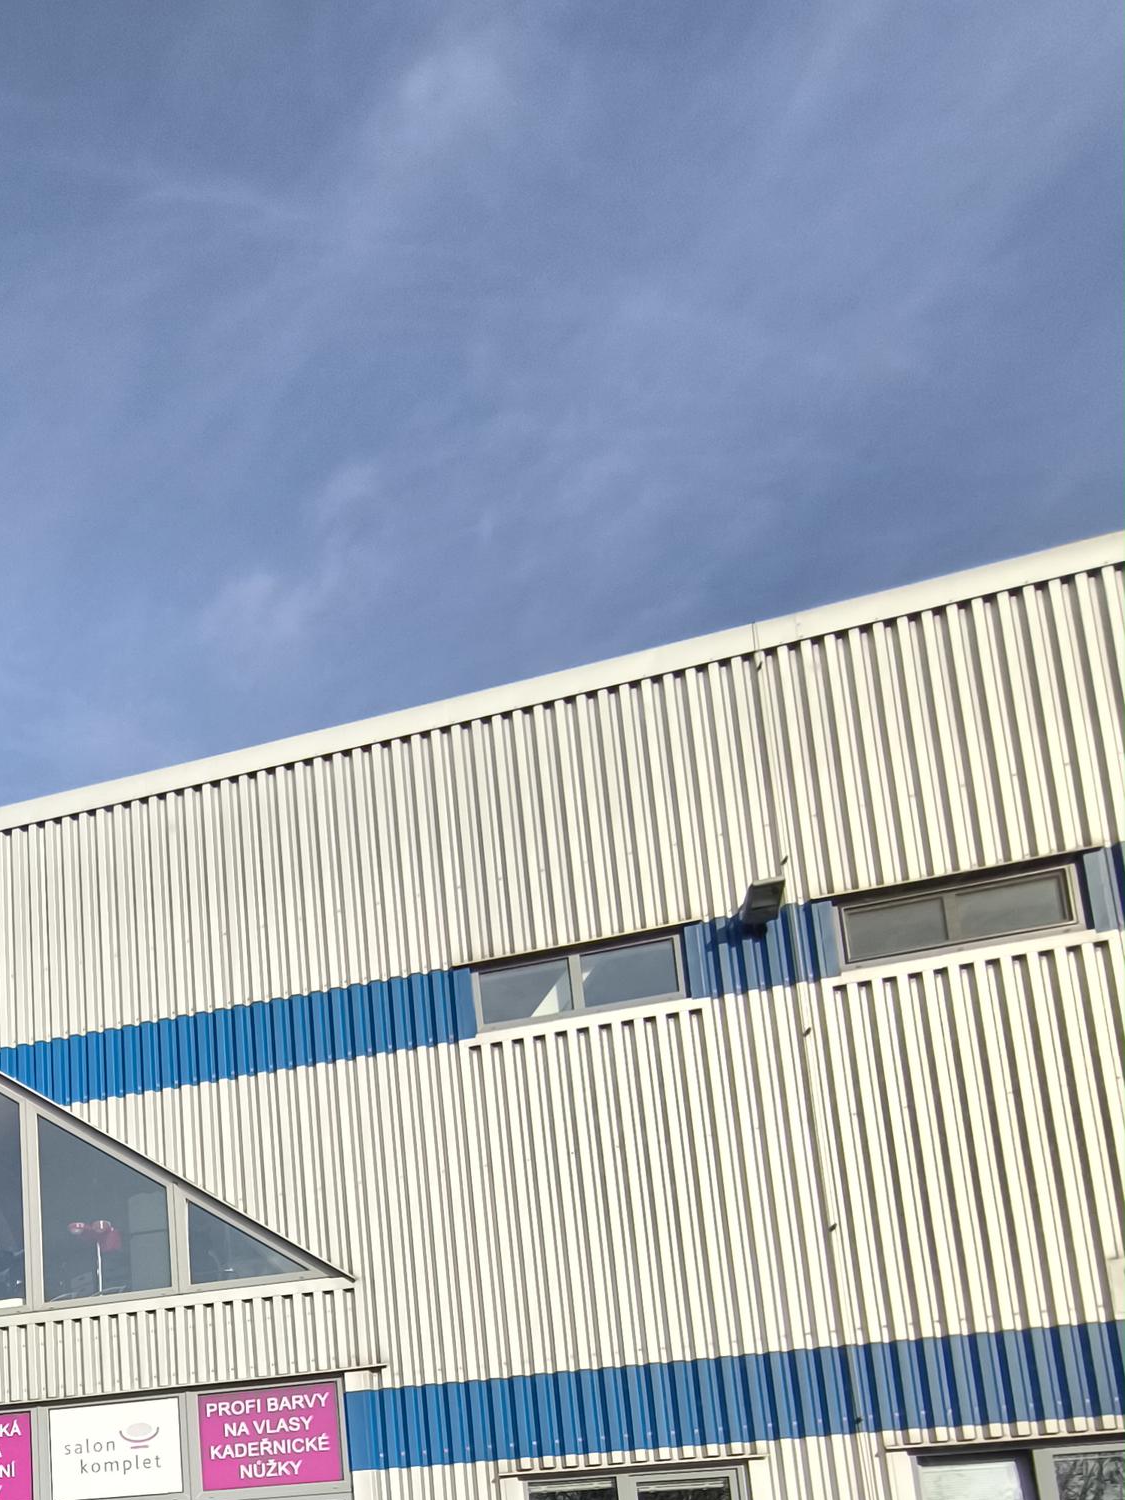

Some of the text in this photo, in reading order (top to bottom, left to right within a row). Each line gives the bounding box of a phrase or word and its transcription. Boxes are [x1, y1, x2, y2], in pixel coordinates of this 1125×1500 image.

[206, 1392, 329, 1418] PROFI BARVY
[224, 1415, 313, 1437] NA VLASY
[64, 1438, 116, 1455] salon
[210, 1432, 330, 1460] KADEŘNICKÉ
[80, 1455, 162, 1475] komplet
[240, 1459, 302, 1479] NŮŽKY
